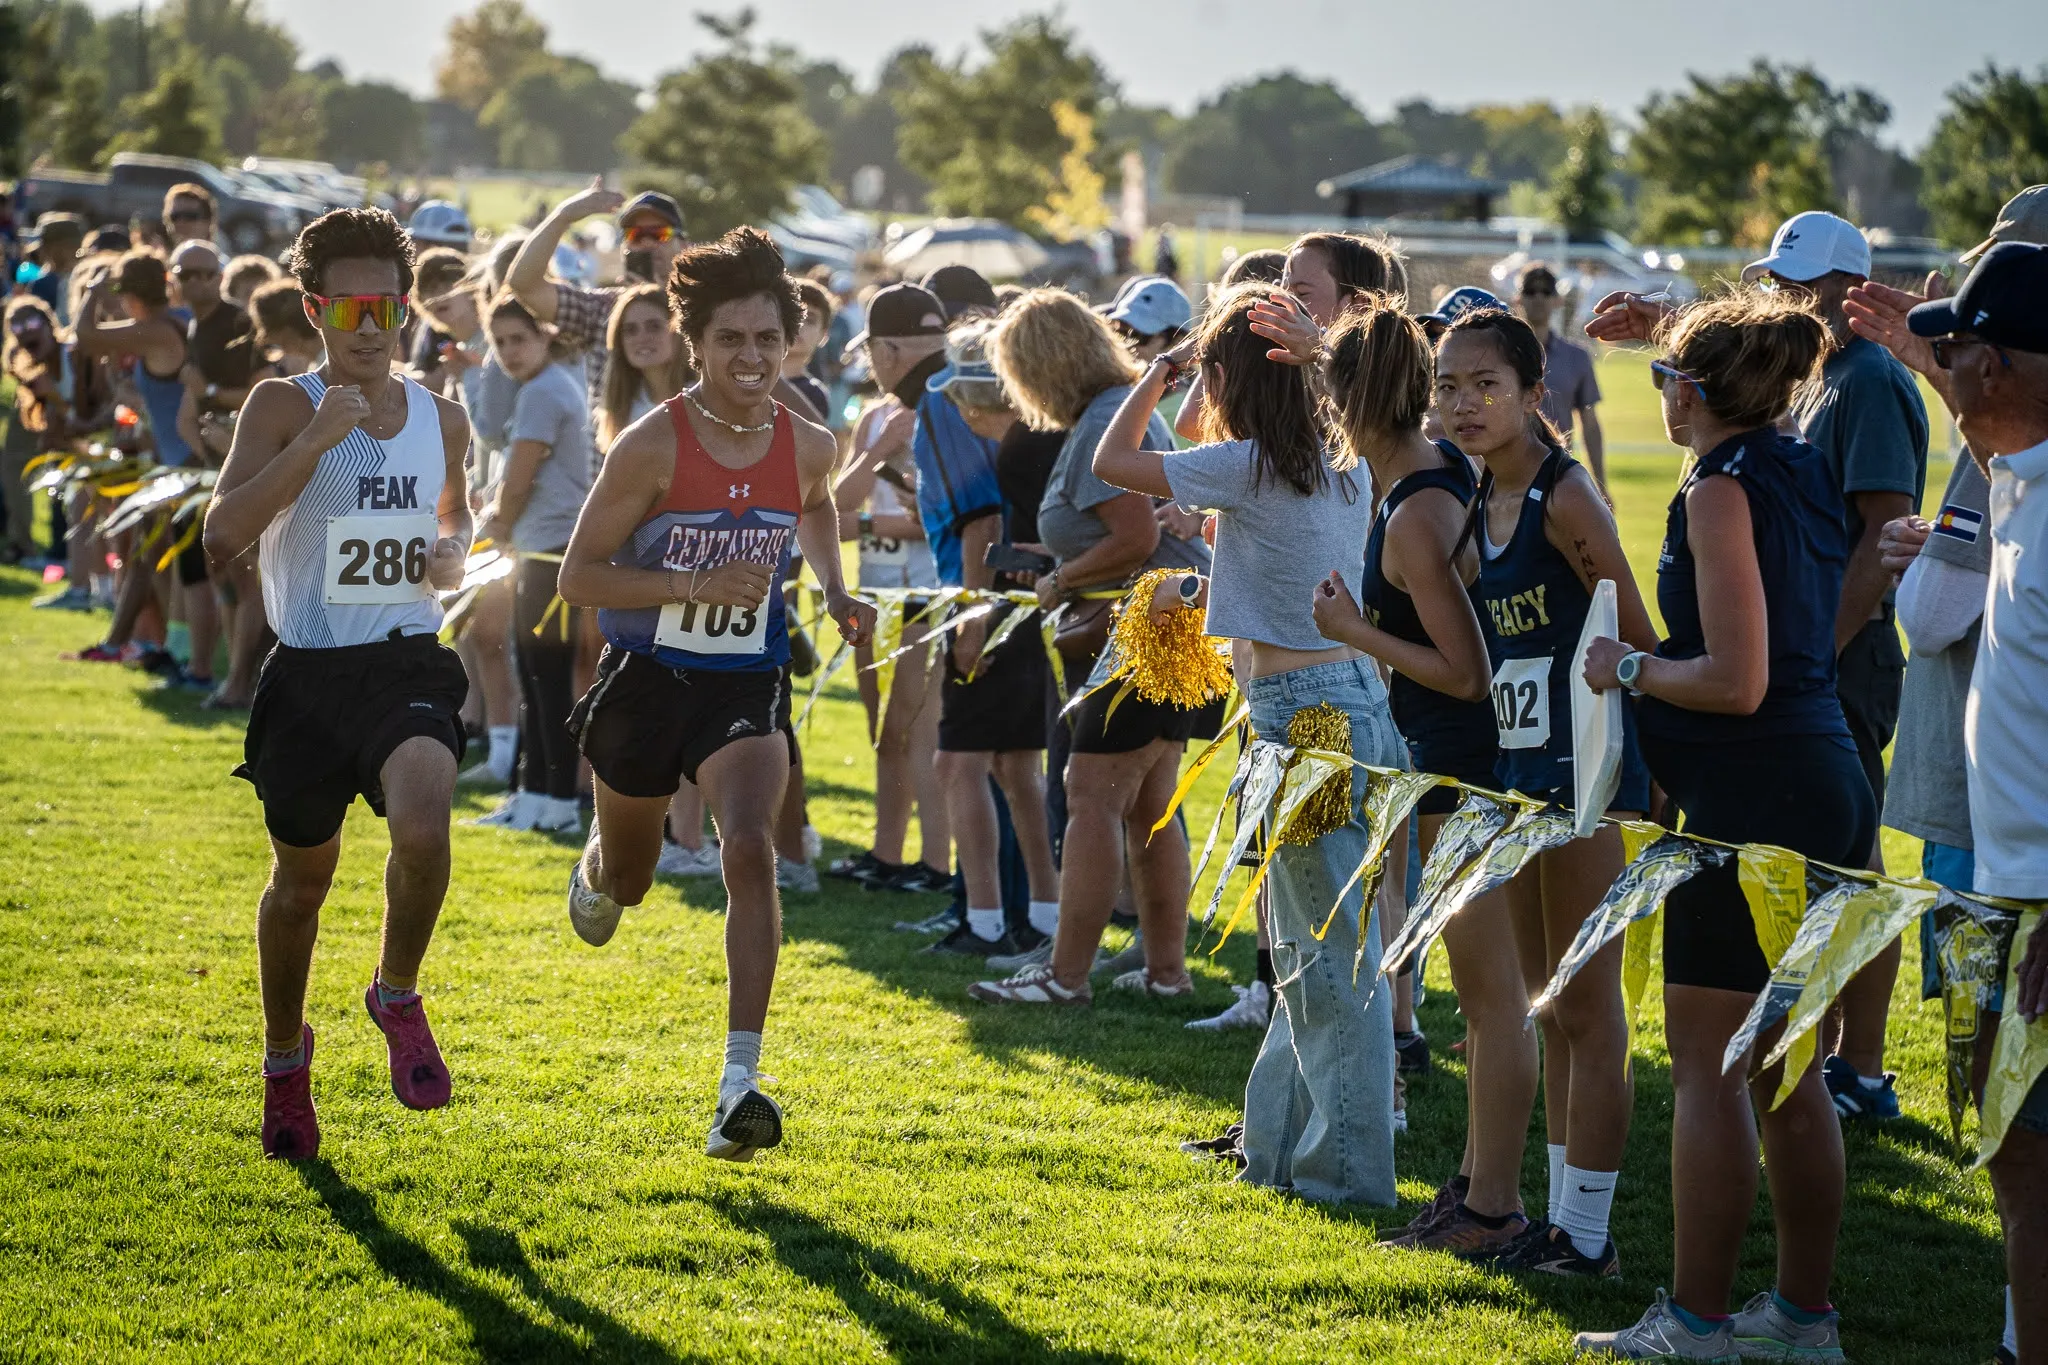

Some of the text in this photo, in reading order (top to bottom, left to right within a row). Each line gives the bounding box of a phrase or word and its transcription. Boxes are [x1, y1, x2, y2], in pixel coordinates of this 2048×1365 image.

[357, 476, 418, 510] PEAK
[338, 537, 427, 587] 286
[680, 602, 757, 638] 103
[1492, 679, 1539, 731] 202
